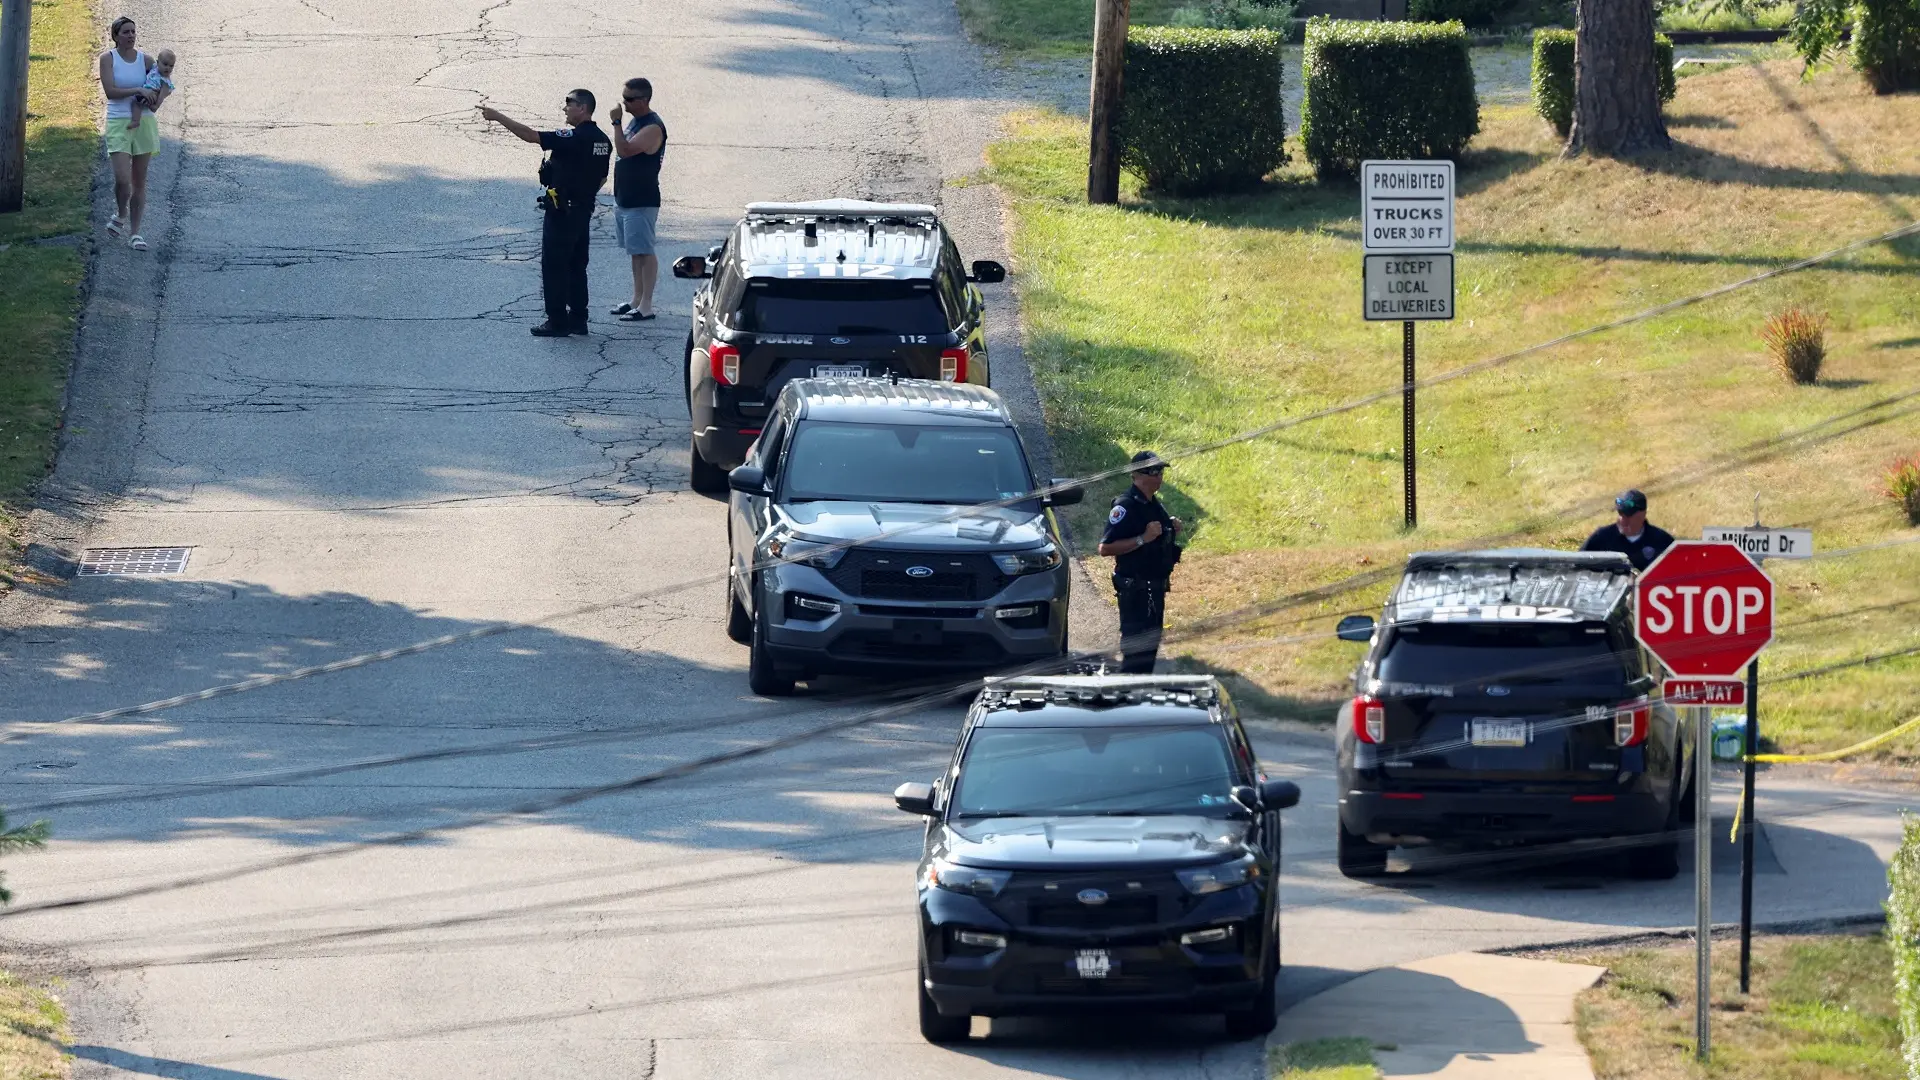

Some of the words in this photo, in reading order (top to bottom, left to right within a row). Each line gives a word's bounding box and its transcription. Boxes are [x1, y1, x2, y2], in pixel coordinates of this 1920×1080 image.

[592, 147, 609, 155] POLICE
[1374, 173, 1445, 189] PROHIBITED
[1373, 208, 1443, 220] TRUCKS
[1373, 227, 1406, 239] OVER
[1410, 227, 1425, 239] 30
[1428, 227, 1443, 239] FT
[814, 263, 895, 278] 112
[1385, 261, 1433, 274] EXCEPT
[1388, 281, 1428, 294] LOCAL
[1372, 299, 1445, 313] DELIVERIES
[755, 334, 814, 345] POLICE
[898, 335, 927, 344] 112
[1780, 535, 1795, 552] Dr
[1481, 605, 1574, 622] 102
[1646, 586, 1764, 634] STOP
[1673, 685, 1698, 700] ALL
[1704, 685, 1734, 701] WAY
[1585, 705, 1608, 719] 102
[1076, 956, 1111, 970] 104
[1080, 969, 1107, 978] POLICE
